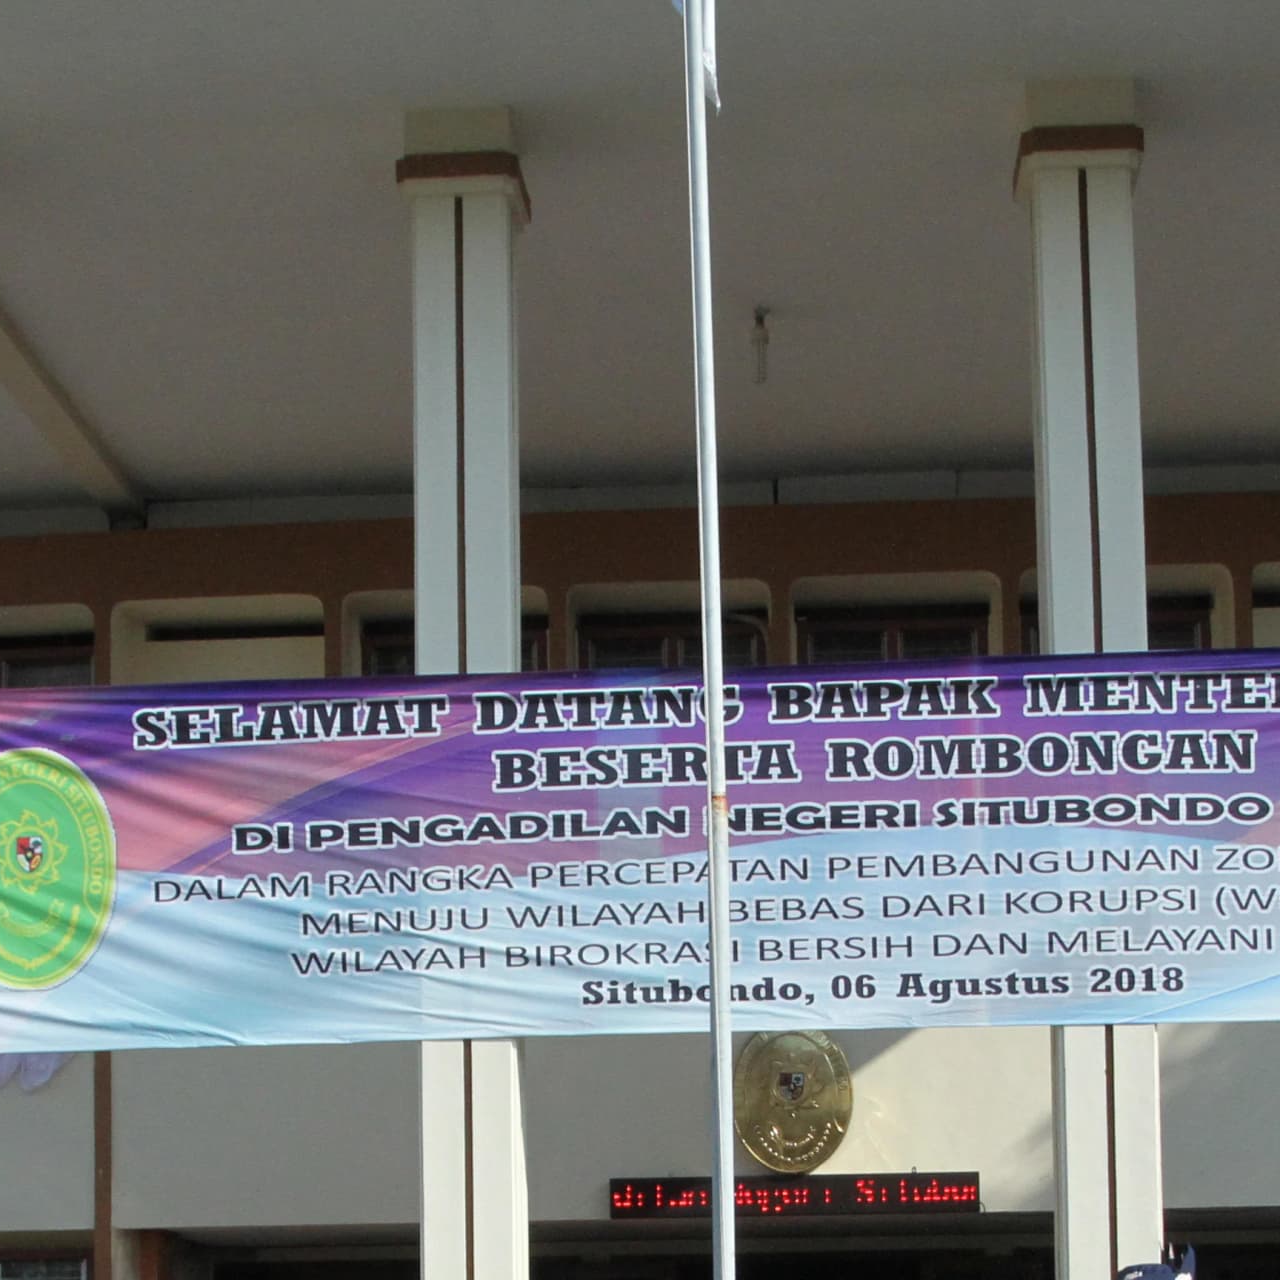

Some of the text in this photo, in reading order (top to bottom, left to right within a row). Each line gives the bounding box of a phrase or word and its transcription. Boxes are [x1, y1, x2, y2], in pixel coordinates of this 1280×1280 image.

[134, 696, 448, 747] SELAMAT
[474, 686, 742, 733] DATANG
[771, 675, 998, 721] BAPAK
[494, 731, 1257, 790] BESERTA ROMBONGAN
[233, 825, 292, 852] DI
[307, 809, 687, 848] PENGADILAN
[936, 795, 1270, 827] SITUBONDO
[154, 875, 310, 902] DALAM
[328, 867, 514, 896] RANGKA
[828, 848, 1199, 880] PEMBANGUNAN
[301, 908, 489, 936] MENUJU
[506, 901, 705, 928] WILAYAH
[726, 896, 864, 922] BEBAS
[882, 892, 985, 919] DARI
[1005, 888, 1197, 915] KORUPSI
[291, 946, 485, 975] WILAYAH
[506, 940, 739, 967] BIROKRAI
[758, 935, 913, 962] BERSIH
[932, 932, 1028, 957] DAN
[1047, 927, 1273, 955] MELAYANI
[830, 974, 876, 999] 06
[896, 972, 1070, 1004] Agustus
[1090, 966, 1185, 993] 2018
